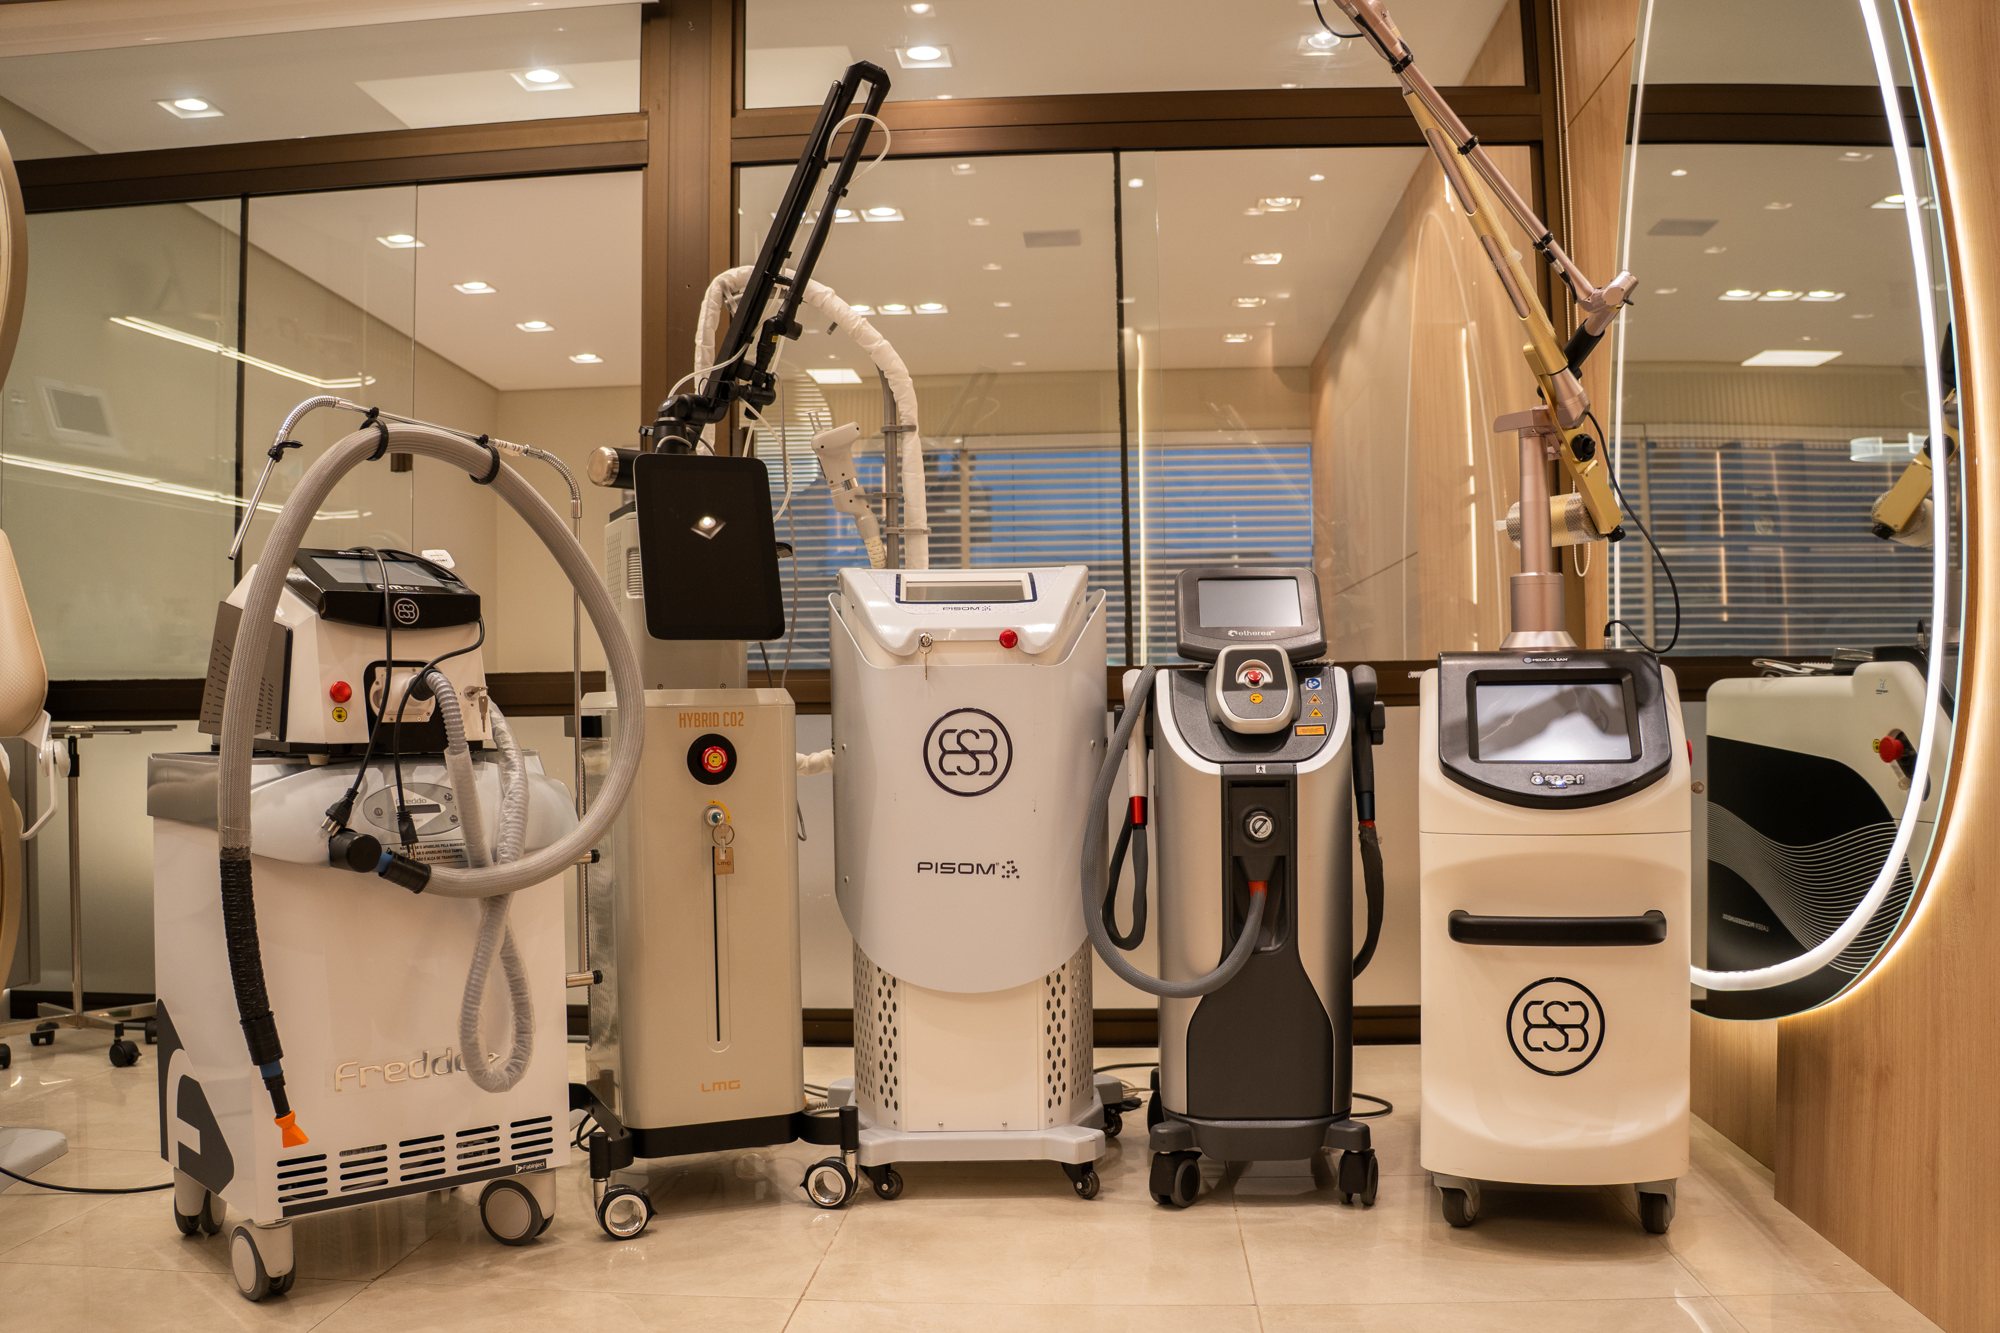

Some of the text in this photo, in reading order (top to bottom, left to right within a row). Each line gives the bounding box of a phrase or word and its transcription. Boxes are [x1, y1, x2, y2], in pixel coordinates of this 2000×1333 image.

[679, 711, 745, 728] HYBRID CO2
[701, 1080, 741, 1093] LMG
